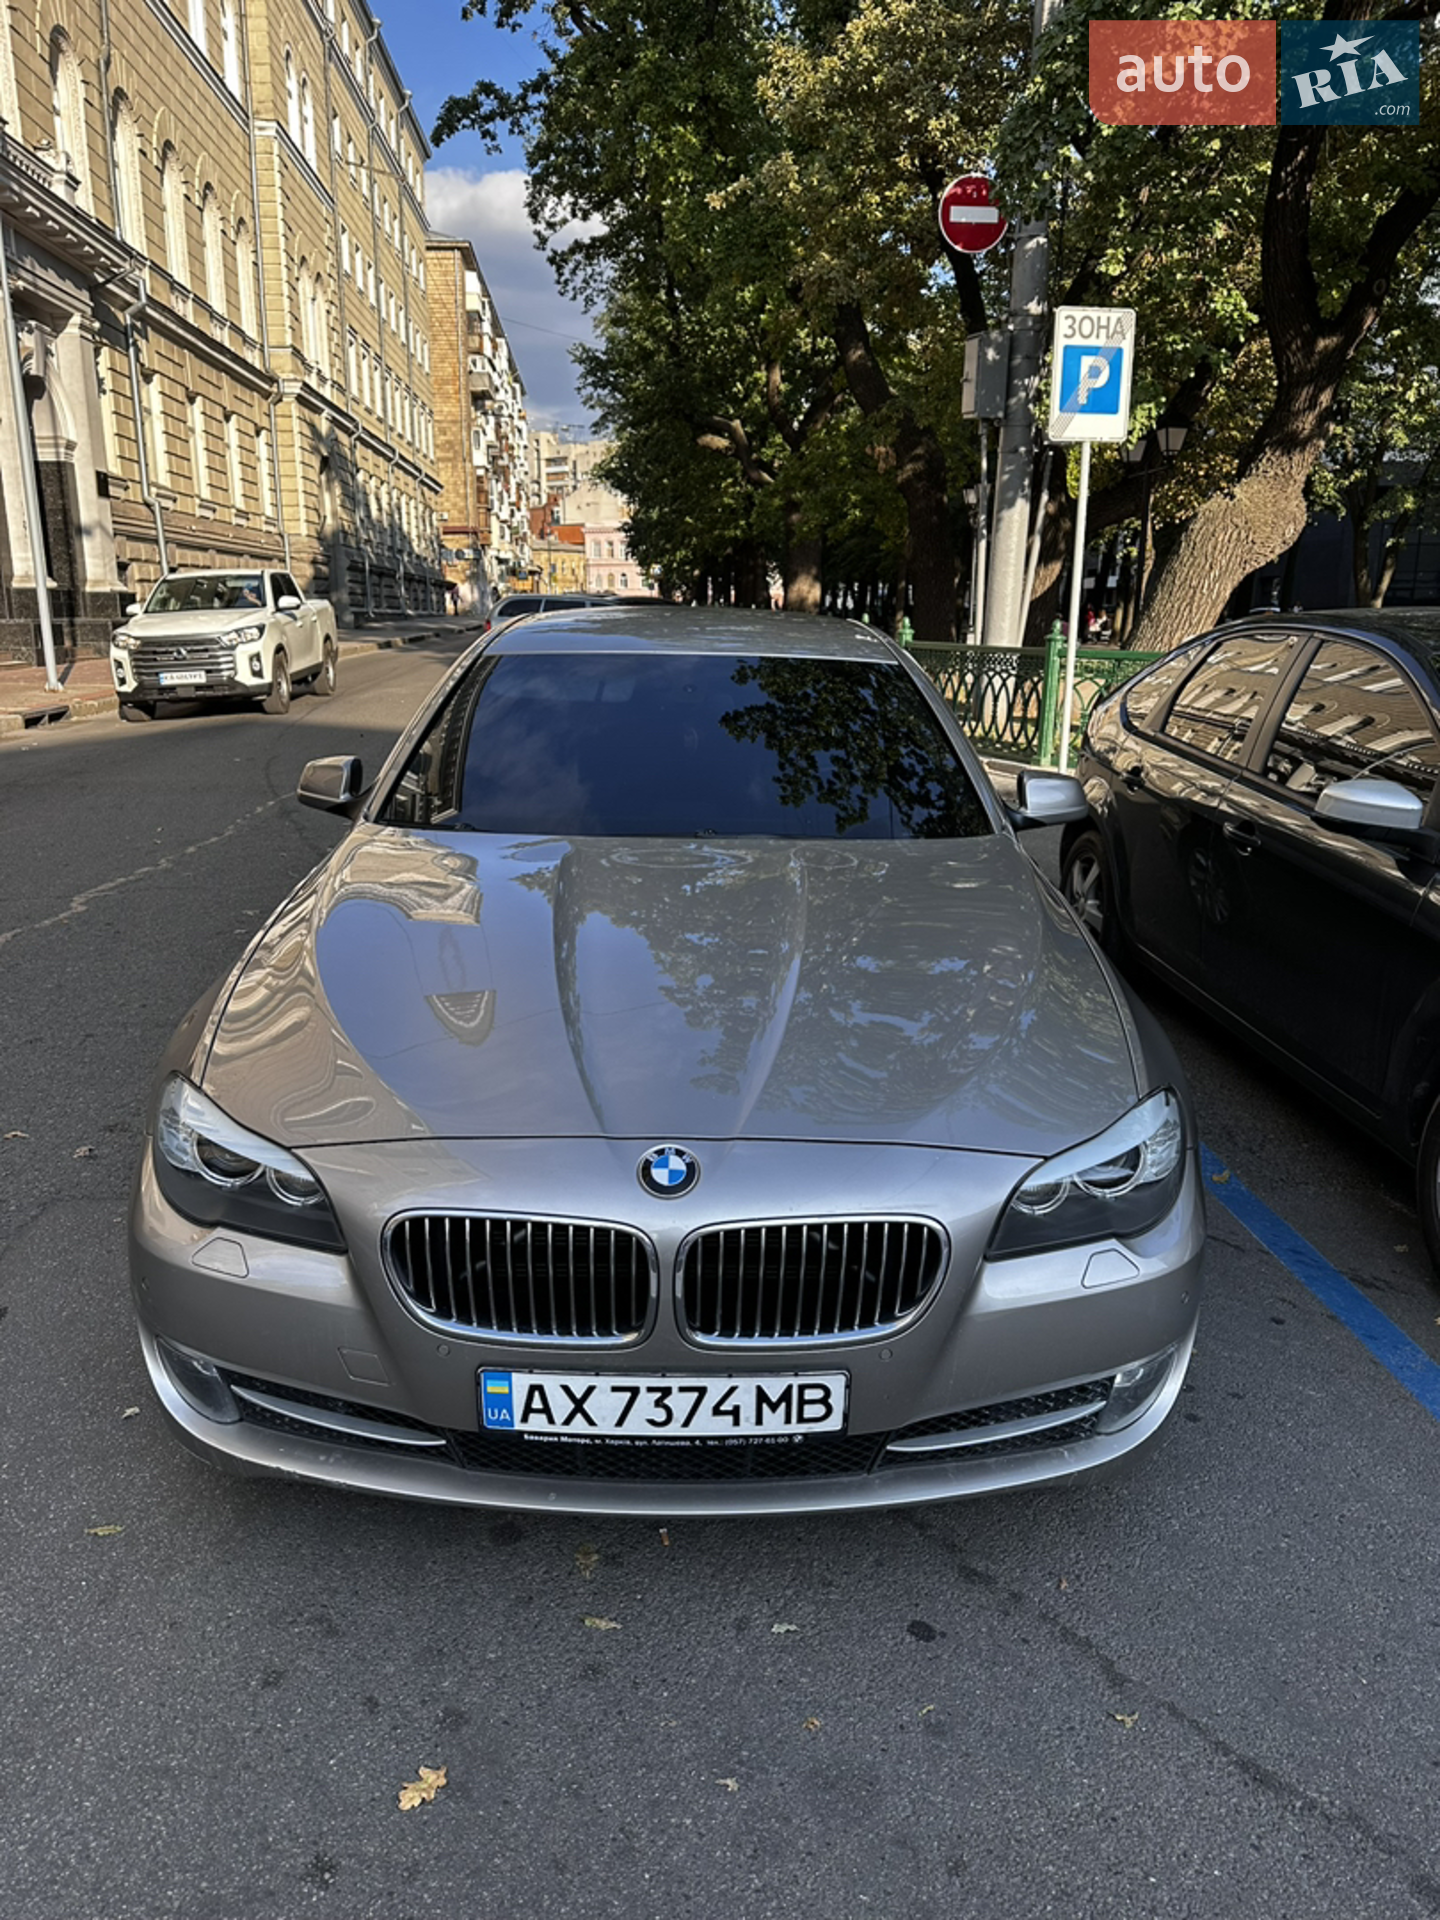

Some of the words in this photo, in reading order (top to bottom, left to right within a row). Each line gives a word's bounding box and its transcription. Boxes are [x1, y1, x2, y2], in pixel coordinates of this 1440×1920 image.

[1063, 314, 1126, 340] ЗОНА
[488, 1408, 511, 1421] UA
[519, 1383, 597, 1427] AX
[610, 1385, 741, 1428] 7374
[755, 1383, 833, 1426] MB
